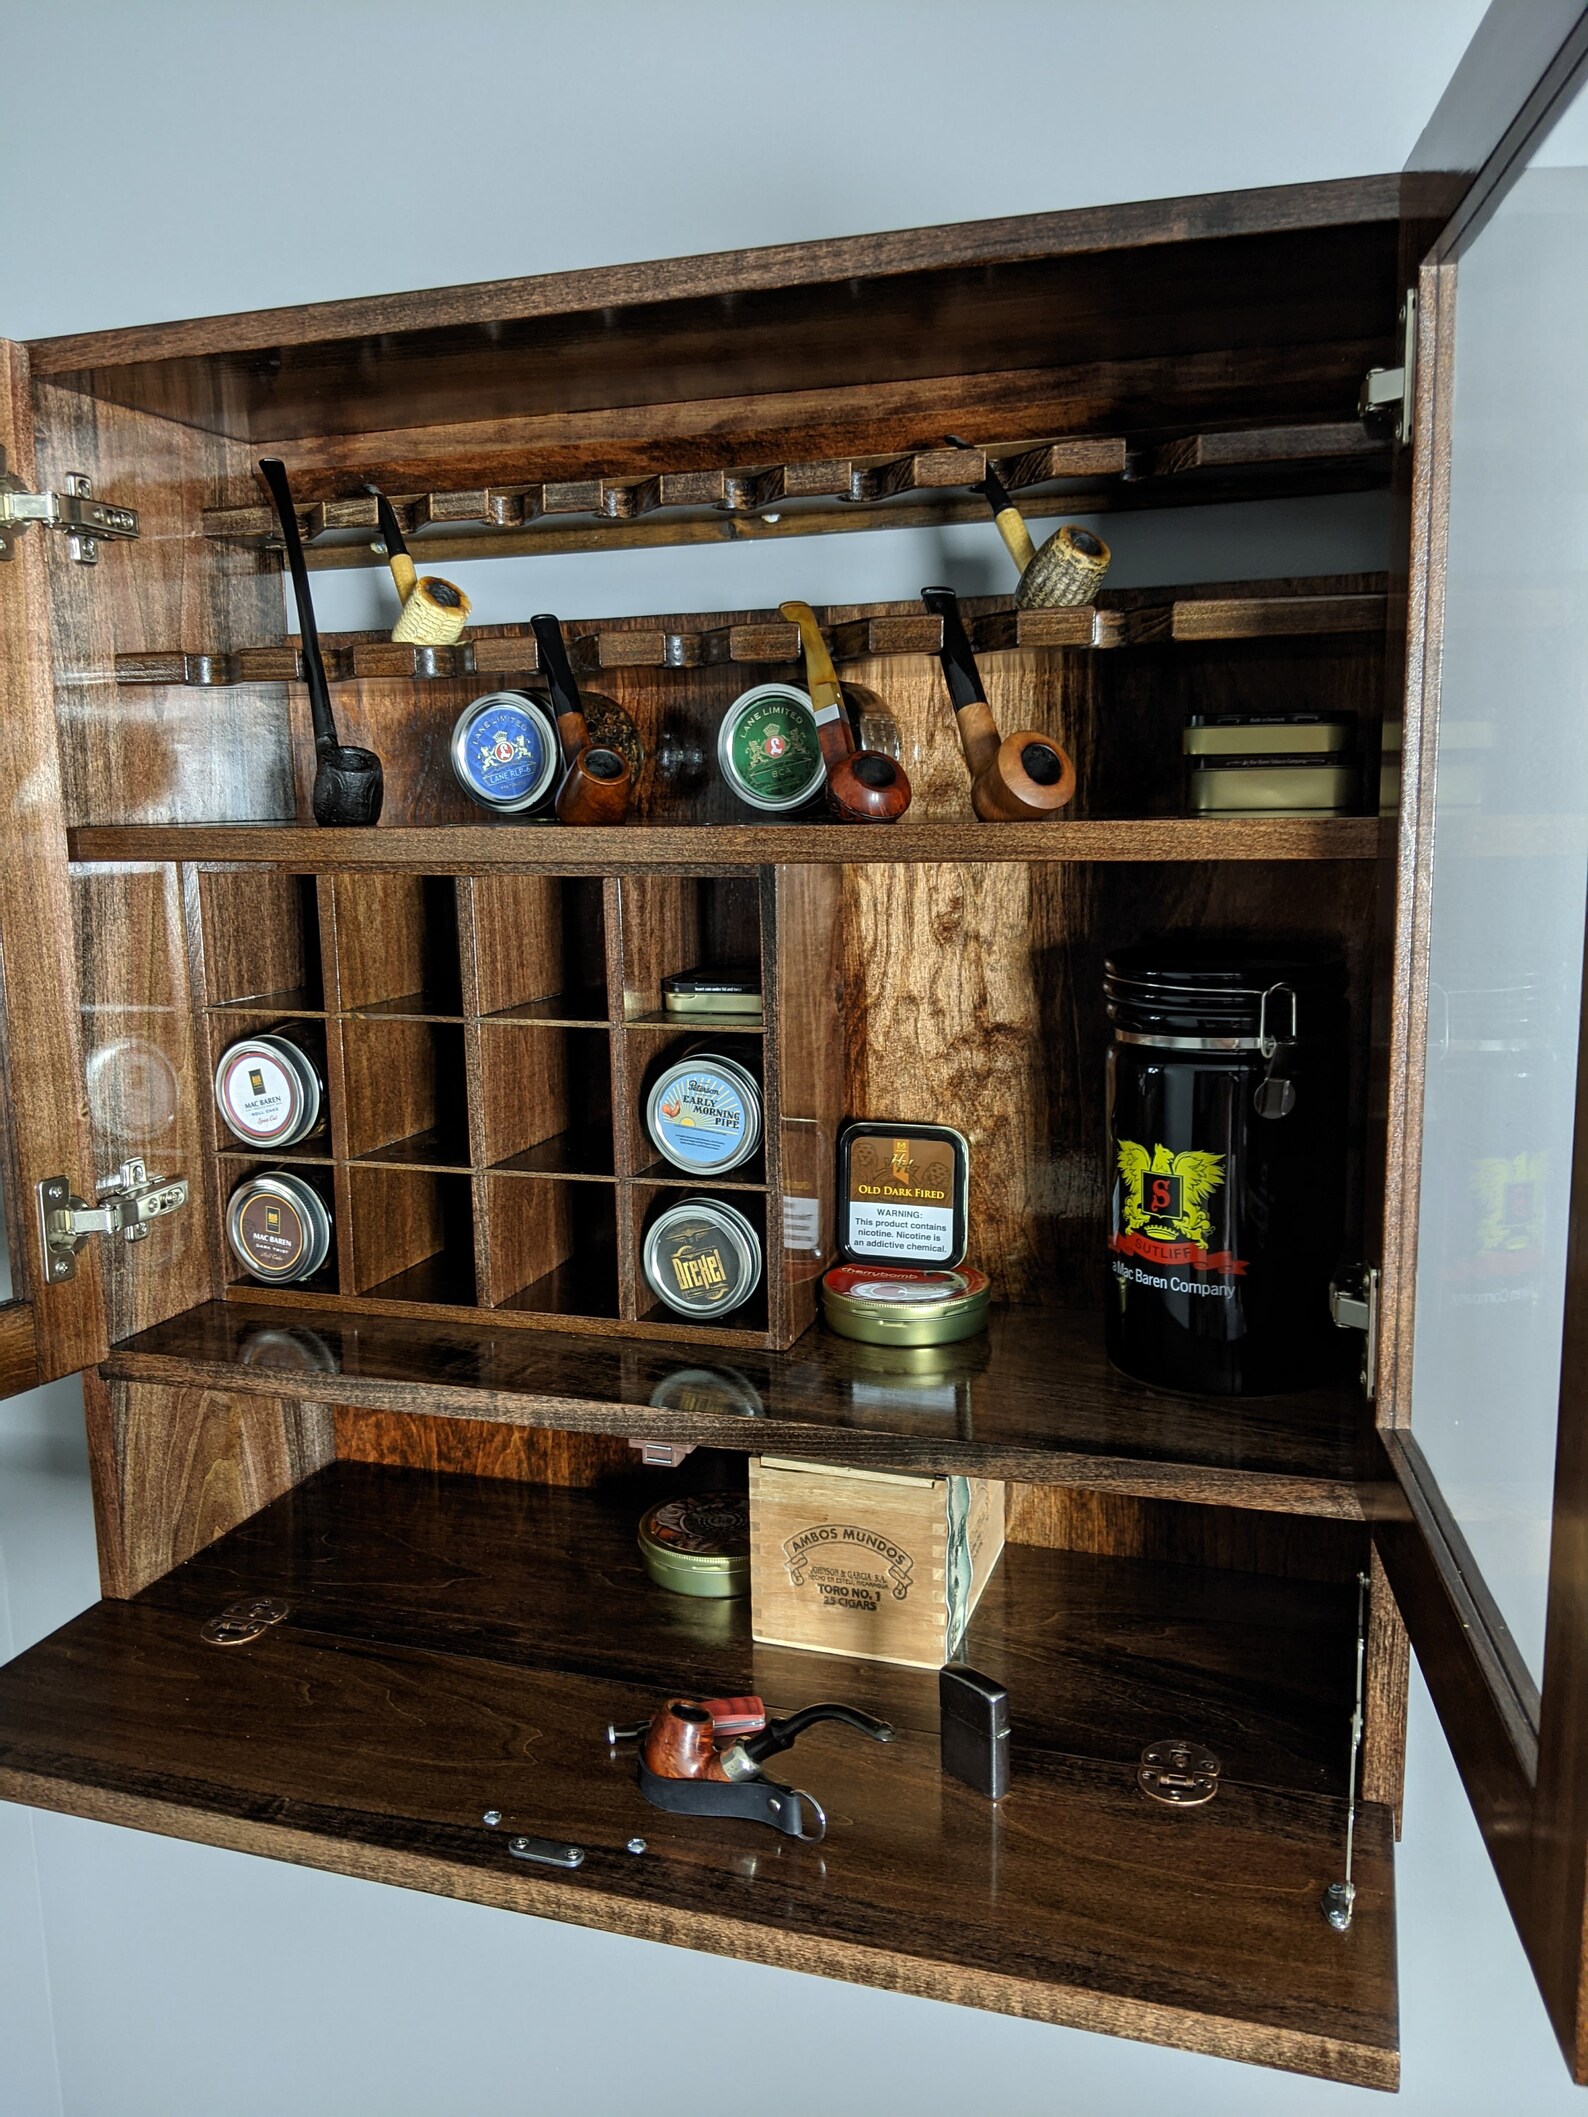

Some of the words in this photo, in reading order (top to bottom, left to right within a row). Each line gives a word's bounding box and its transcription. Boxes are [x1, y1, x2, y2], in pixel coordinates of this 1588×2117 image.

[741, 712, 761, 739] LANE
[762, 706, 804, 725] LIMITED
[490, 773, 508, 784] LANE
[510, 766, 531, 777] RLP-6
[772, 767, 792, 778] BCA
[688, 1080, 719, 1095] Peterson
[245, 1100, 260, 1109] MAC
[260, 1095, 282, 1106] BAREN
[683, 1095, 718, 1107] EARLY
[693, 1105, 740, 1121] MORNING
[715, 1117, 740, 1129] PIPE
[1151, 1179, 1172, 1212] S
[876, 1208, 923, 1219] WARNING:
[855, 1217, 873, 1226] This
[875, 1220, 909, 1229] product
[910, 1222, 947, 1232] contains
[253, 1232, 270, 1242] MAC
[269, 1235, 292, 1247] BAREN
[857, 1228, 894, 1238] nicotine.
[896, 1230, 932, 1241] Nicotine
[933, 1233, 942, 1242] is
[853, 1239, 864, 1247] an
[866, 1239, 905, 1250] addictive
[906, 1242, 947, 1254] chemical.
[1134, 1238, 1192, 1259] SUTLIFF
[841, 1267, 918, 1280] cherrybomb
[1135, 1268, 1168, 1290] Baren
[1170, 1276, 1236, 1299] Company
[792, 1528, 838, 1552] AMBOS
[842, 1528, 906, 1565] MUNDOS
[810, 1566, 839, 1577] JOHNSON
[817, 1583, 849, 1597] TORO
[851, 1588, 872, 1600] NO.
[874, 1591, 881, 1602] 1
[823, 1595, 836, 1605] 25
[838, 1598, 877, 1611] CIGARS
